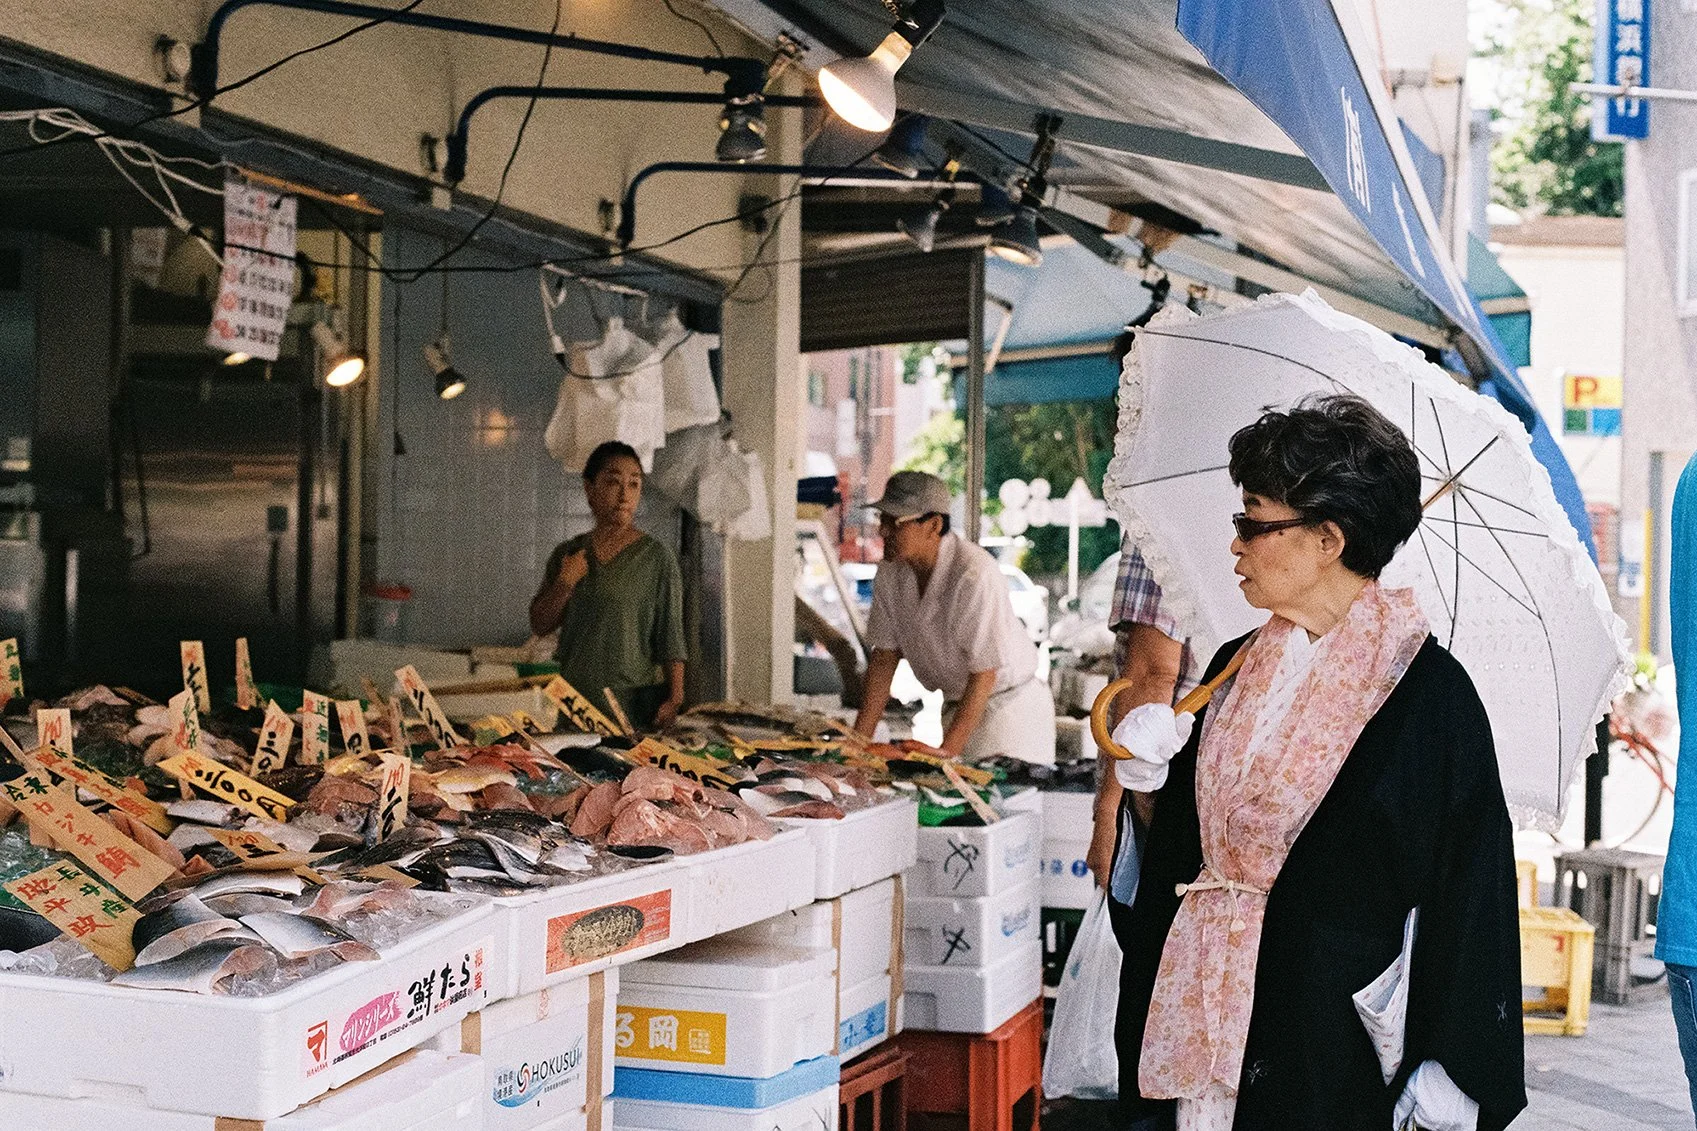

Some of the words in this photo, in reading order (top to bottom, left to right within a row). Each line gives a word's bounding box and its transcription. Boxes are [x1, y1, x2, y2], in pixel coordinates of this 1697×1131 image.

[1574, 376, 1599, 404] P
[407, 953, 470, 1019] 鮮たら
